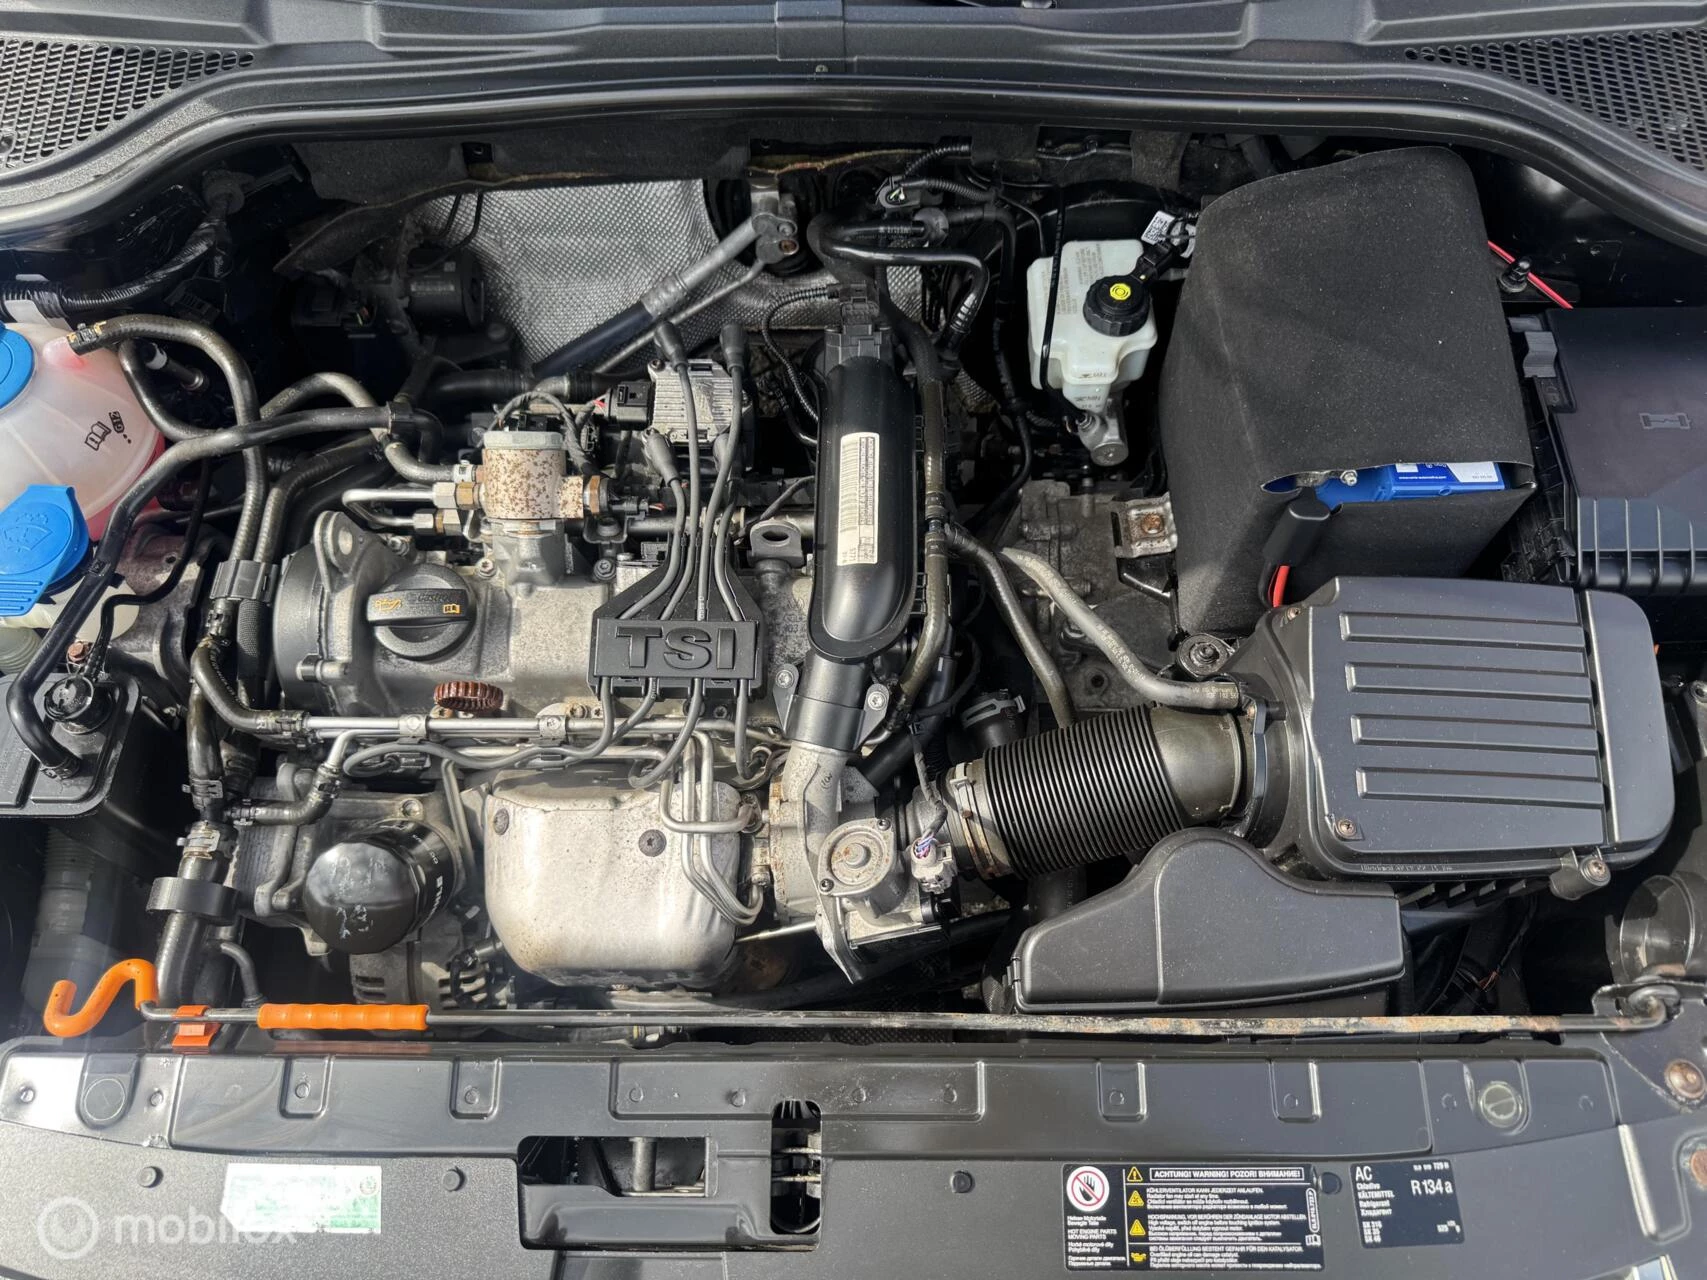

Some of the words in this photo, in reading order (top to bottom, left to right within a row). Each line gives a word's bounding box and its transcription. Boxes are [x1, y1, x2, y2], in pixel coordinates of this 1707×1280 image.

[615, 625, 737, 671] TSI
[1154, 1170, 1192, 1178] ACHTUNG!
[1192, 1170, 1229, 1178] WARNING!
[1230, 1170, 1257, 1178] POZOR!
[1355, 1165, 1373, 1182] AC
